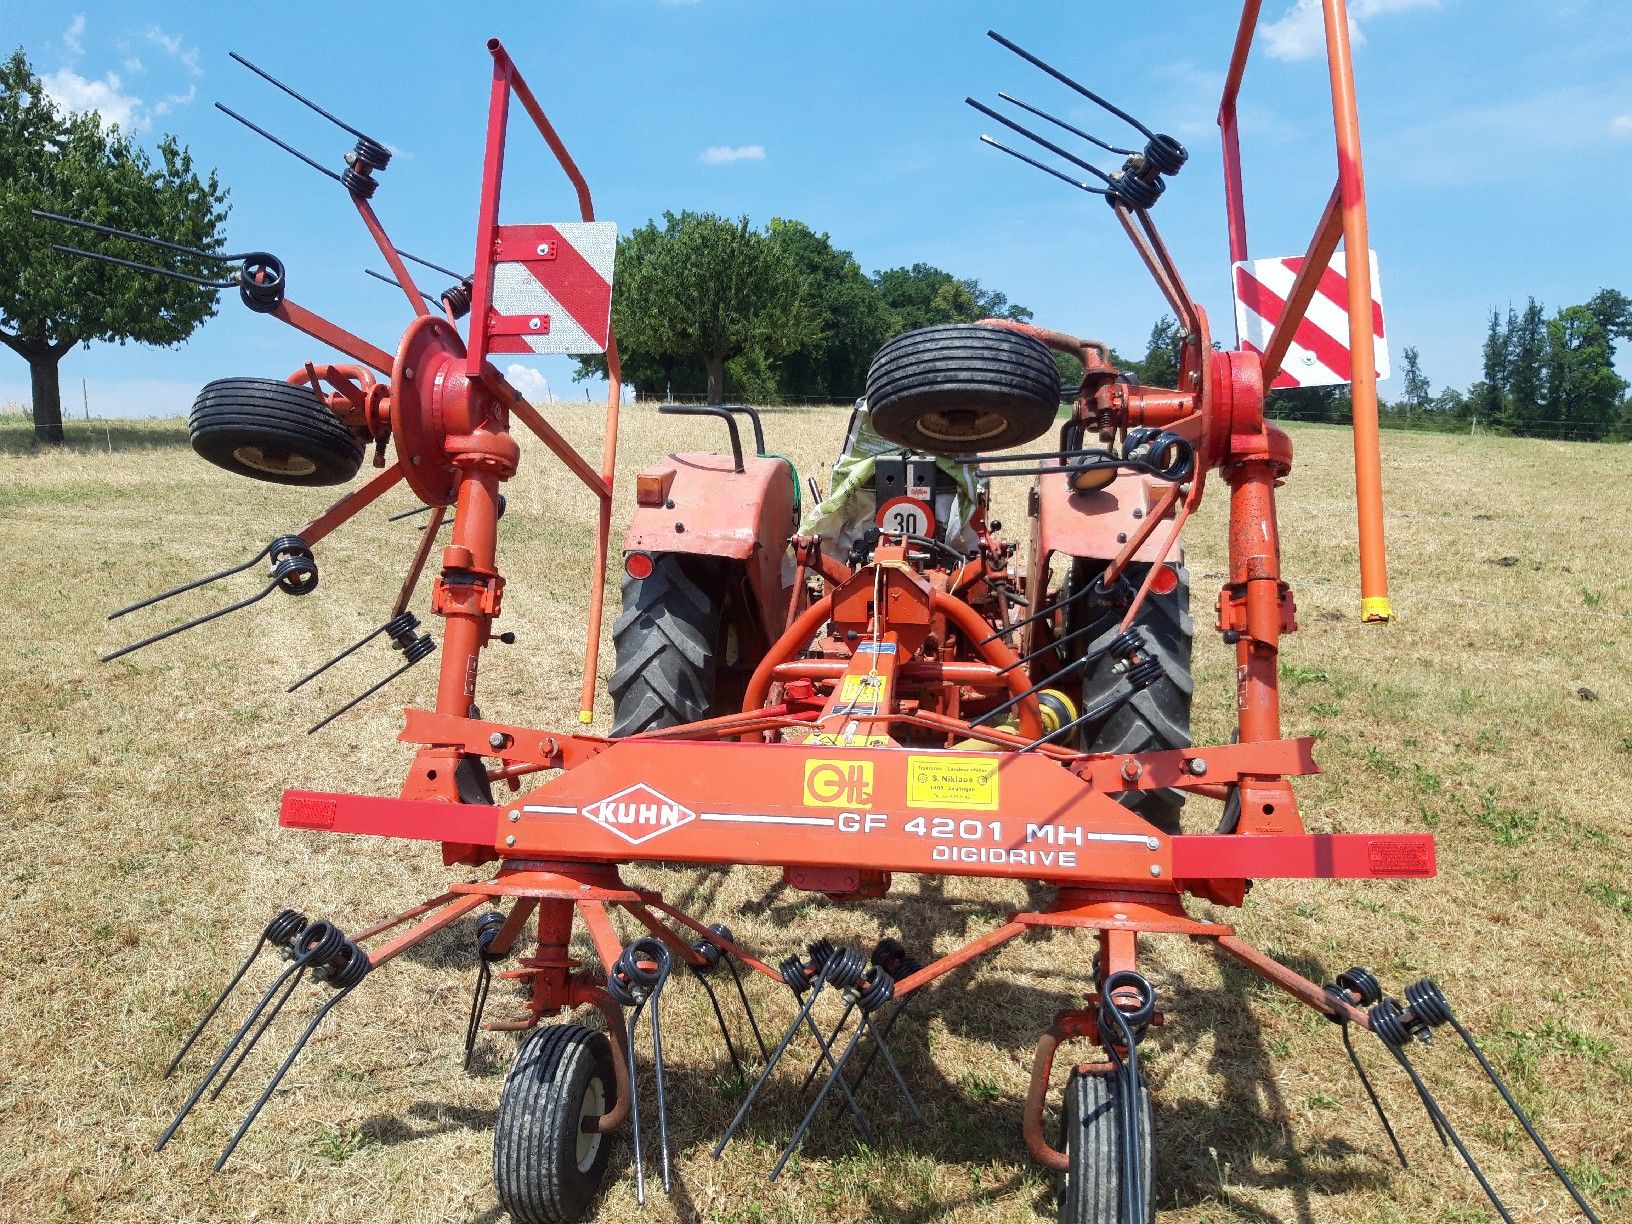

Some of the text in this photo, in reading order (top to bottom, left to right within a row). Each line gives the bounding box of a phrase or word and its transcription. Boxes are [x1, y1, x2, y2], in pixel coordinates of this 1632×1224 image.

[893, 513, 917, 534] 30
[941, 775, 974, 783] Niklaus
[598, 802, 679, 825] KUHN
[838, 812, 1082, 846] GF 4201 MH
[932, 845, 1077, 867] DIGIDRIVE
